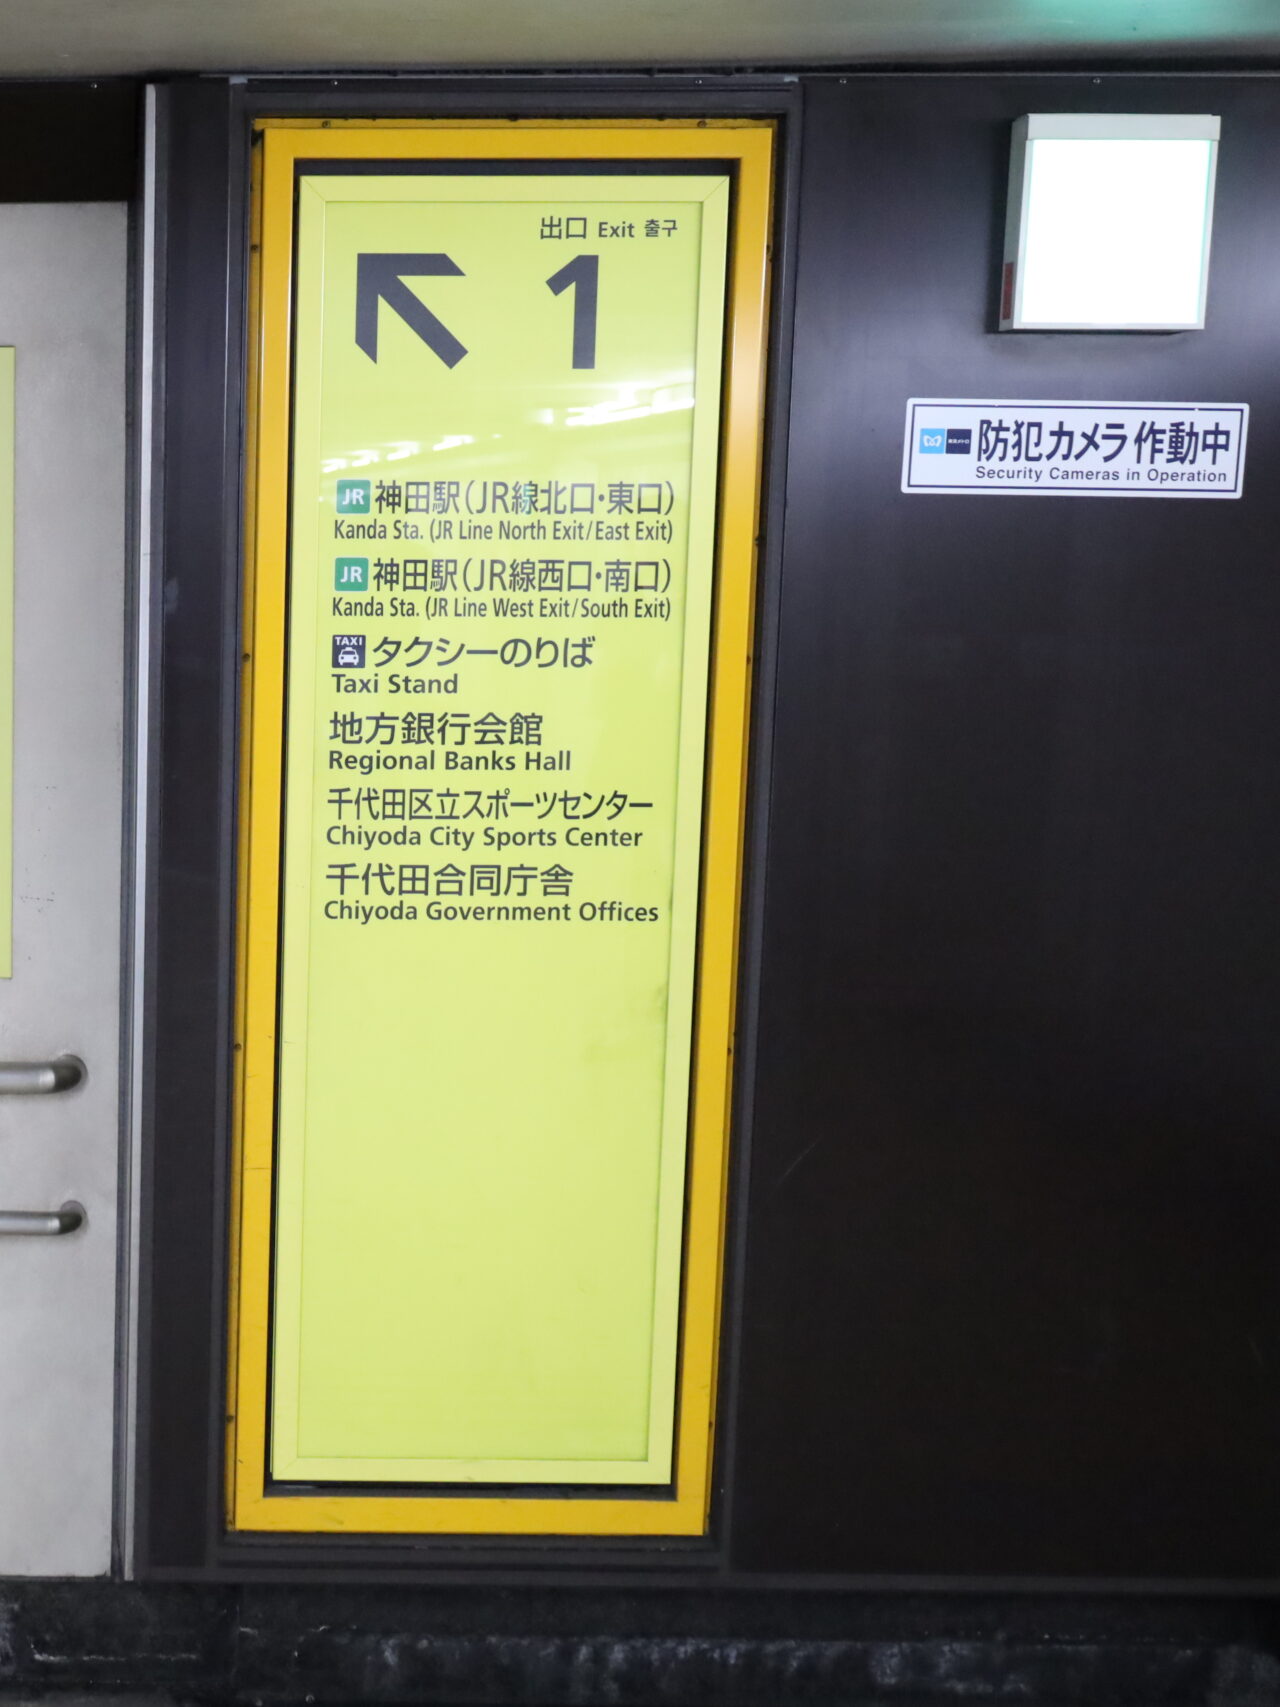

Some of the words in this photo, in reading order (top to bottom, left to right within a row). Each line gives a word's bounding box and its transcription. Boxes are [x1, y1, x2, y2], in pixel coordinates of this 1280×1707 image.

[540, 216, 587, 240] 出口
[598, 221, 635, 238] Exit
[644, 219, 678, 238] 출구
[545, 255, 599, 369] 1
[977, 419, 1230, 465] 防犯カメラ作動中
[976, 466, 1042, 482] Security
[1049, 467, 1119, 481] Cameras
[1127, 469, 1140, 481] in
[1147, 469, 1227, 484] Operation
[342, 489, 364, 505] JR
[334, 519, 387, 539] Kanda
[393, 520, 423, 539] Sta.
[430, 519, 453, 542] (JR
[459, 520, 492, 539] Line
[498, 520, 546, 540] North
[636, 519, 672, 542] Exit)
[340, 567, 362, 582] JR
[332, 598, 384, 617] Kanda
[390, 598, 419, 617] Sta.
[426, 598, 448, 620] (JR
[454, 598, 487, 618] Line
[493, 598, 533, 618] West
[634, 598, 671, 621] Exit)
[335, 637, 362, 645] TAXI
[372, 636, 596, 668] タクシーのりば
[332, 674, 378, 693] Taxi
[388, 674, 458, 694] Stand
[329, 711, 543, 746] 地方銀行会館
[329, 750, 435, 774] Regional
[445, 750, 516, 770] Banks
[525, 751, 570, 770] Hall
[328, 787, 653, 820] 千代田区立スポーツセンター
[326, 826, 421, 850] Chiyoda
[430, 827, 475, 850] City
[483, 827, 557, 851] Sports
[565, 828, 642, 847] Center
[326, 862, 573, 896] 千代田合同庁舎
[324, 900, 418, 924] Chiyoda
[426, 902, 571, 922] Government
[579, 902, 659, 922] Offices
